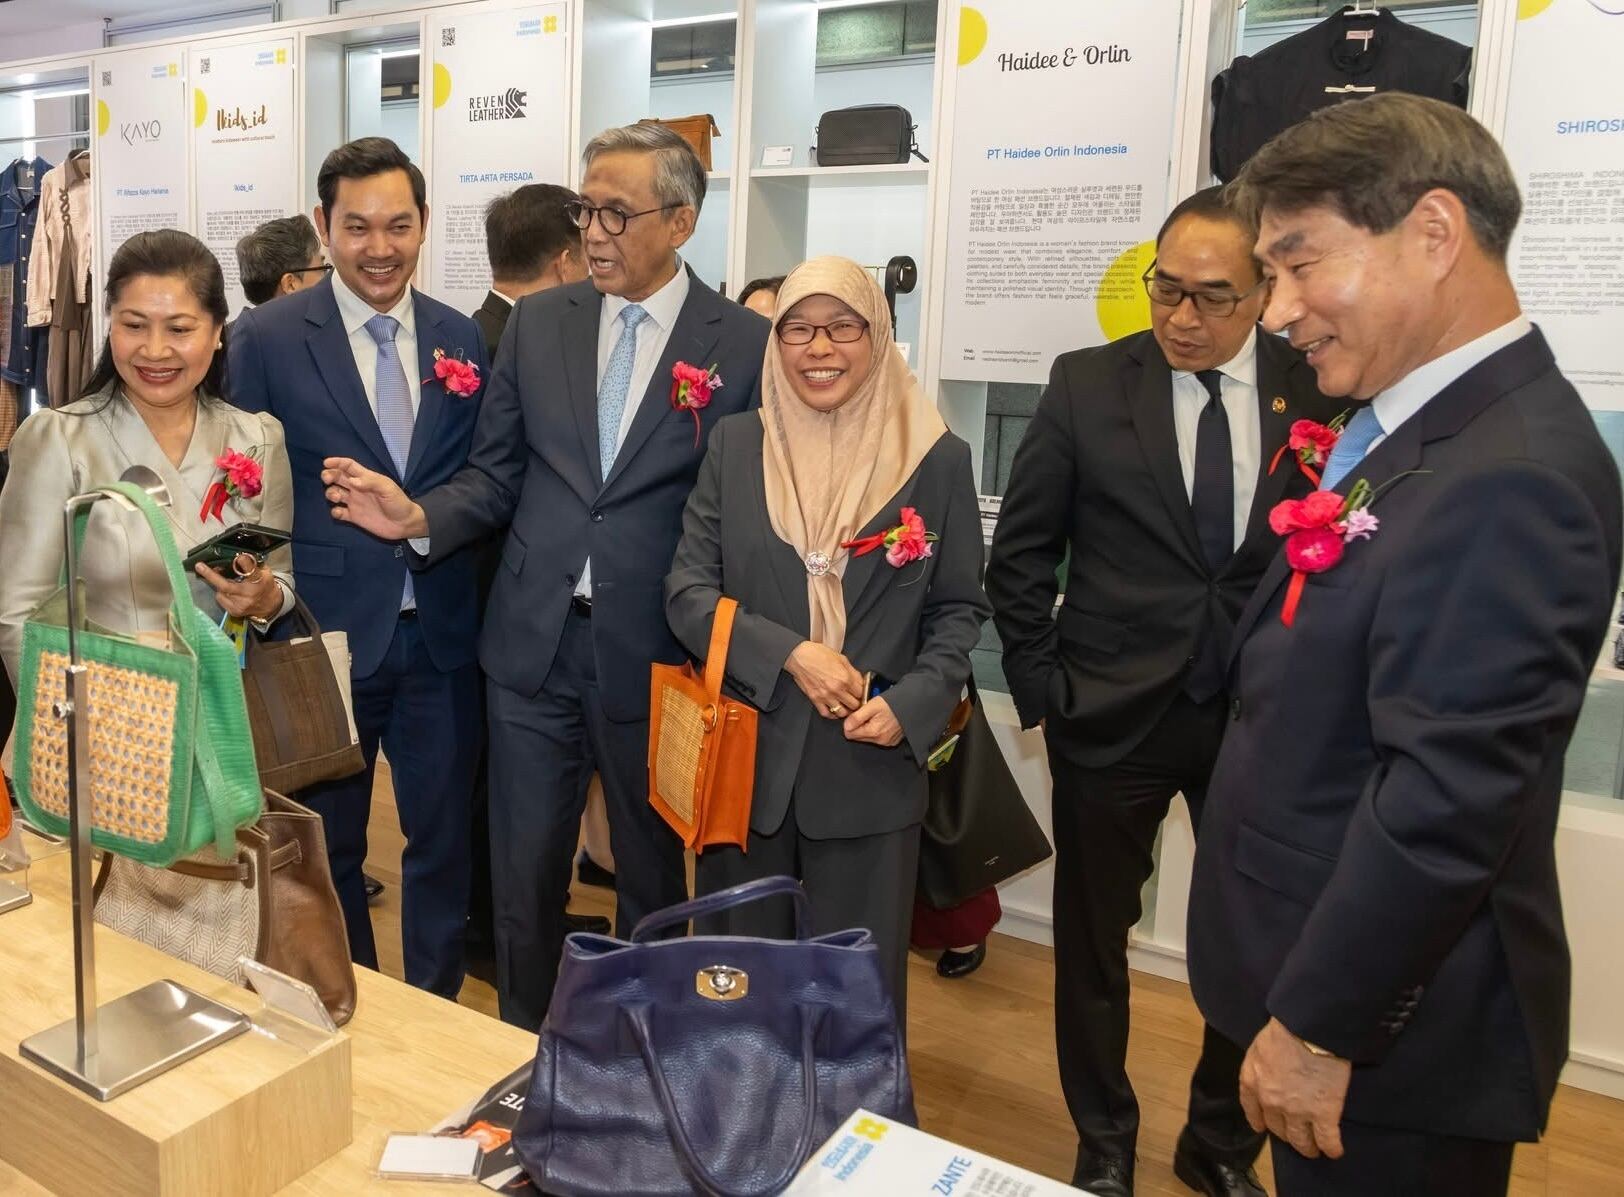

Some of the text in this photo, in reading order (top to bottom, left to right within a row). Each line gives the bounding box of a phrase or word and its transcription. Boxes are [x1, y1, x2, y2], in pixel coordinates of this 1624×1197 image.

[998, 45, 1132, 72] Haidee & Orlin
[470, 96, 504, 109] REVEN
[469, 108, 504, 122] LEATHER
[120, 120, 161, 146] KAYO
[987, 144, 1128, 159] PT Haidee Orlin Indonesia
[460, 172, 533, 183] TIRTA ARTA PERSADA
[932, 1156, 972, 1196] ZANTE
